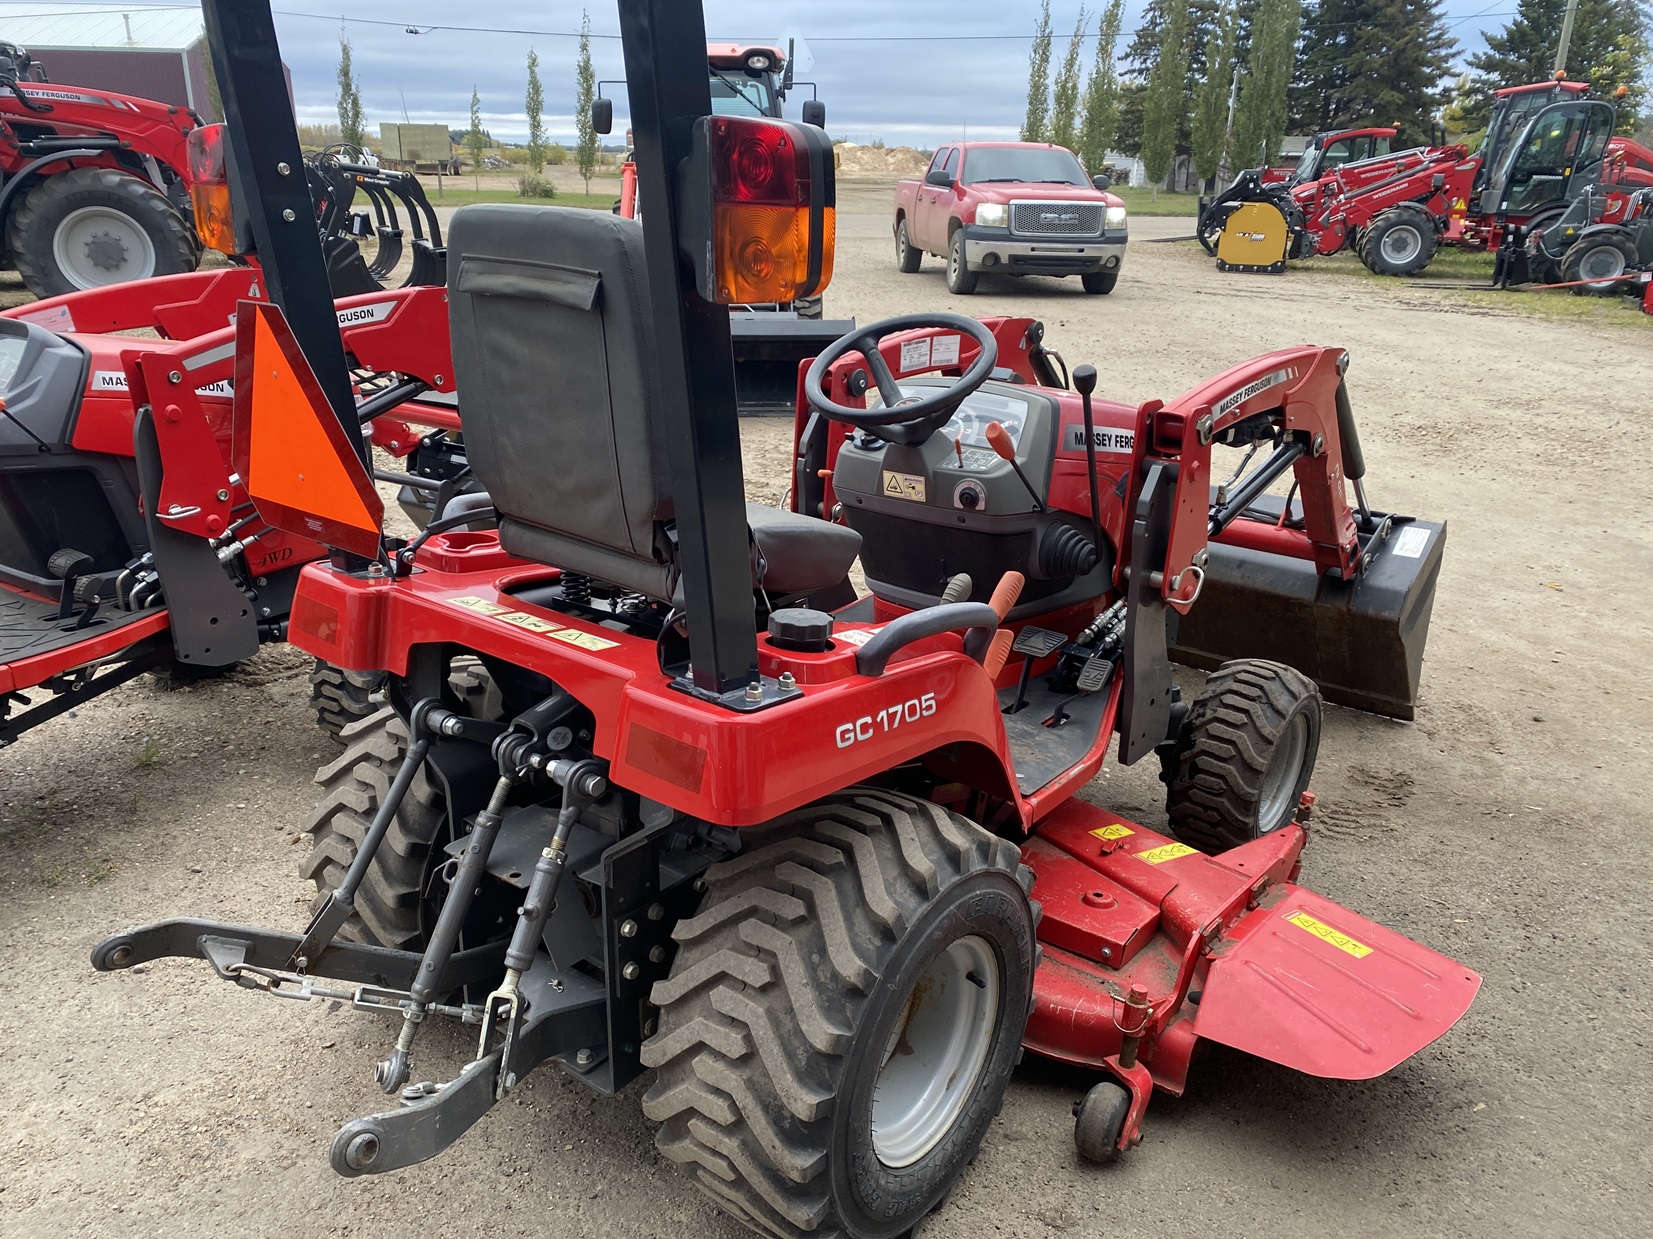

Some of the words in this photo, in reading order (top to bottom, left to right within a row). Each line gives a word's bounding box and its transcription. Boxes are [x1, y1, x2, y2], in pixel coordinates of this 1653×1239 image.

[9, 89, 40, 98] MSEY
[42, 91, 81, 101] FERGUSON
[1372, 182, 1409, 199] WEIDEMANN
[337, 308, 375, 323] GUSON
[1220, 390, 1244, 415] MASSEY
[1244, 376, 1273, 399] FERGUSON
[1074, 431, 1113, 447] MSEY
[260, 547, 293, 566] 4WD
